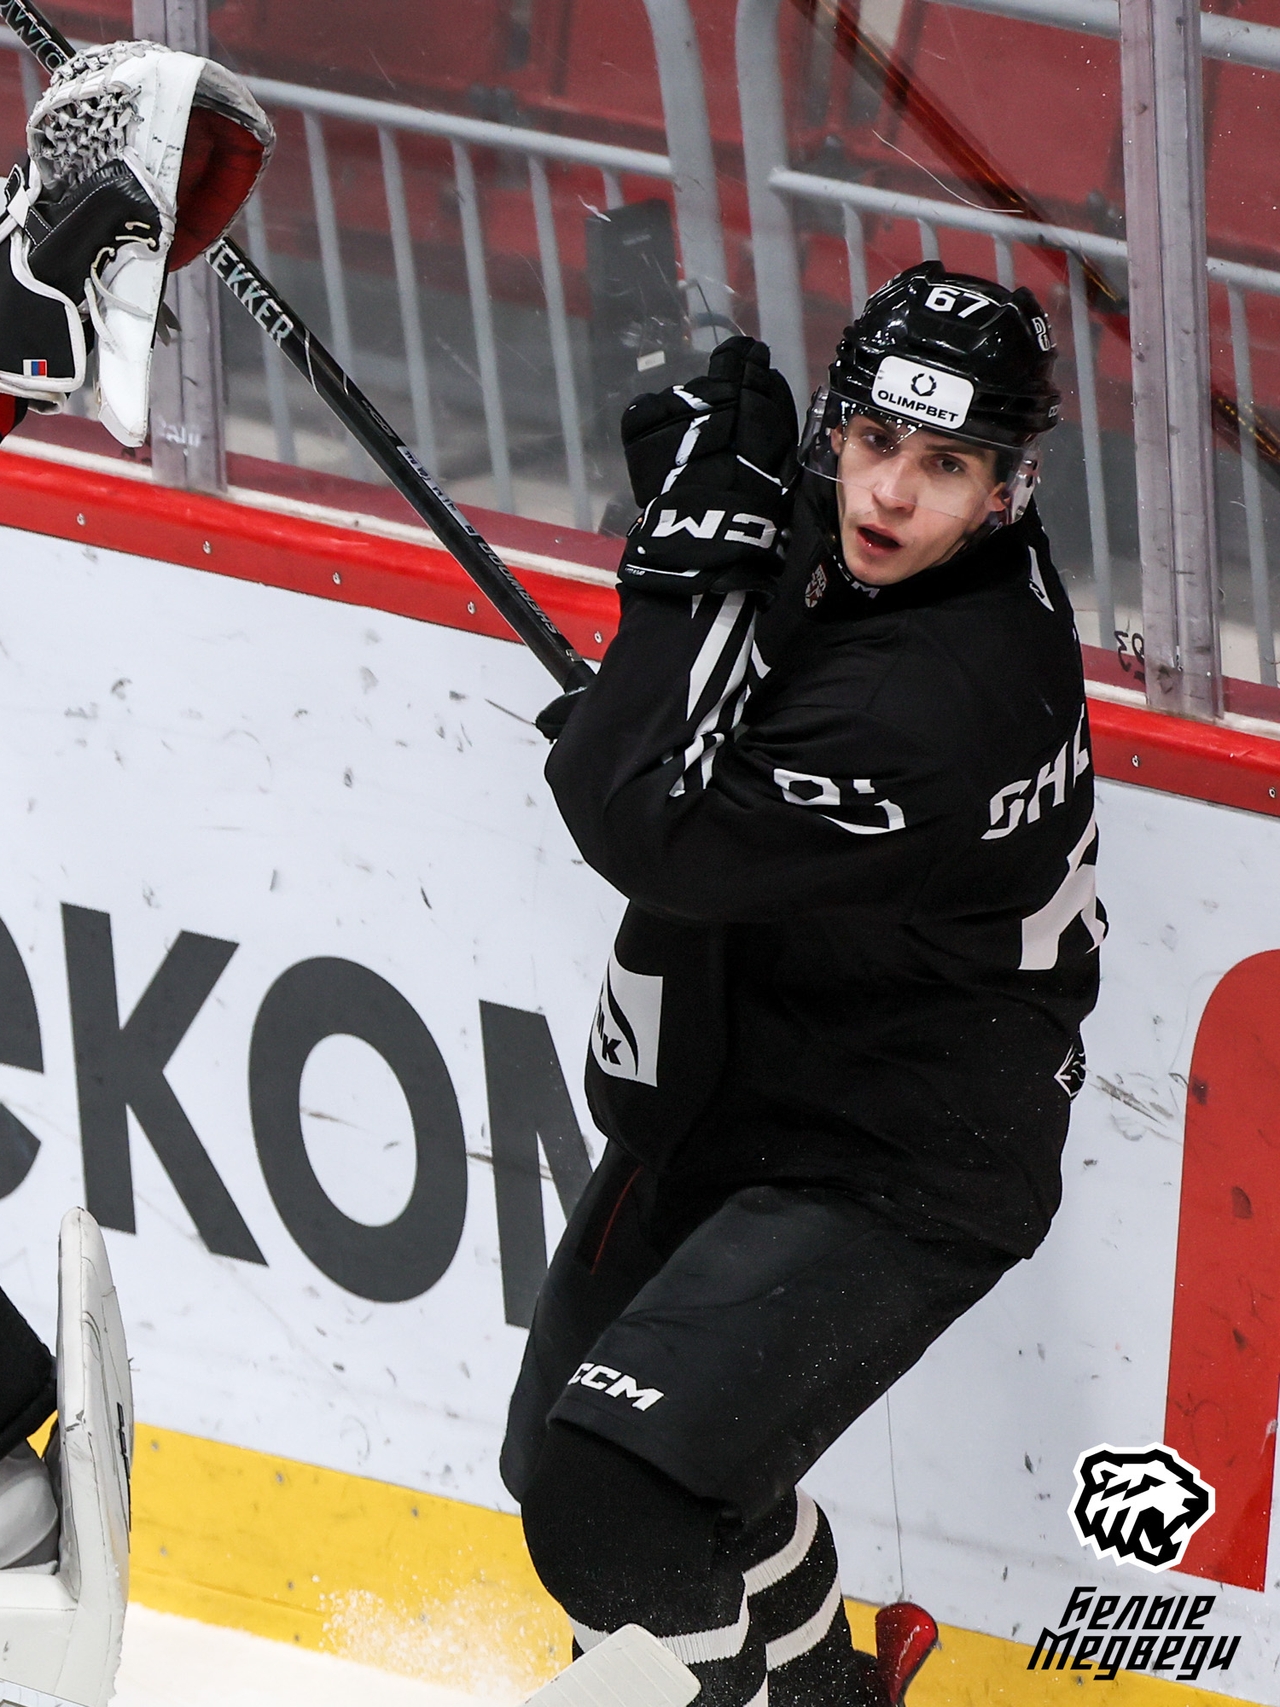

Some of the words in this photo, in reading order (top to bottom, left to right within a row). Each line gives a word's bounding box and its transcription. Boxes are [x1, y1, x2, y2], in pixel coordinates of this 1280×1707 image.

[925, 286, 990, 319] 67
[877, 390, 959, 423] OLIMPBET
[650, 509, 778, 550] CM
[567, 1362, 665, 1412] CCM
